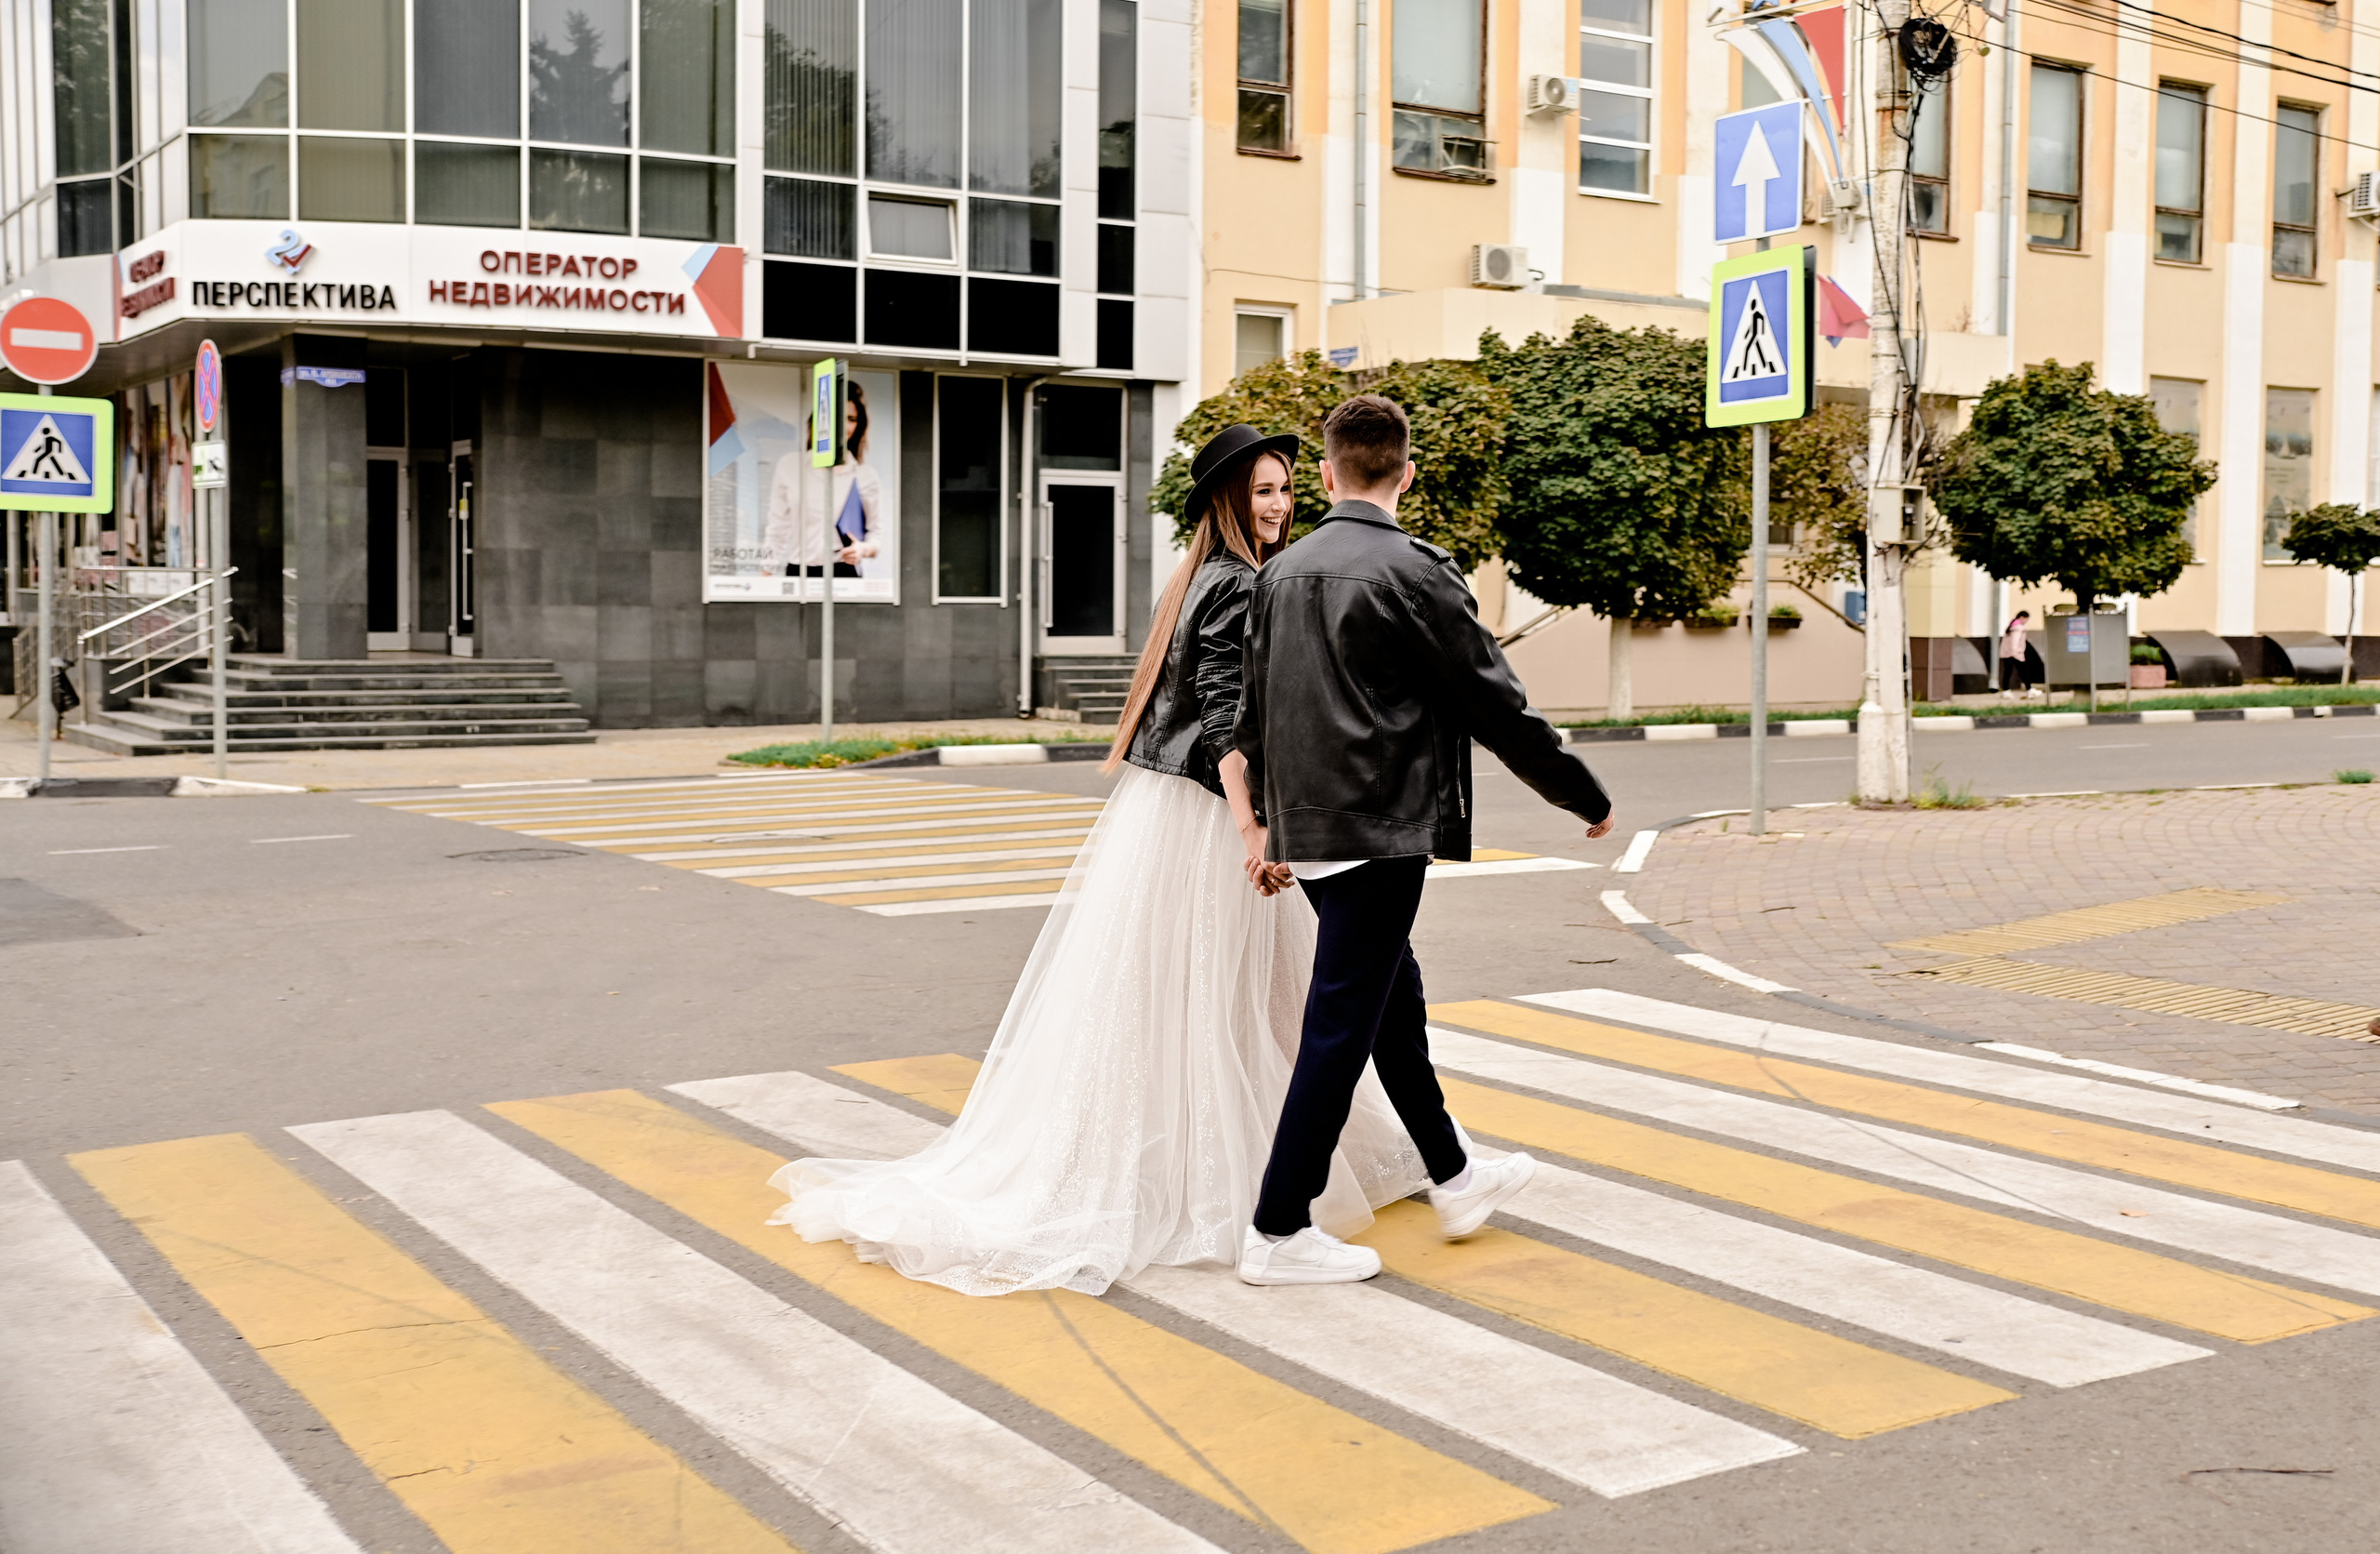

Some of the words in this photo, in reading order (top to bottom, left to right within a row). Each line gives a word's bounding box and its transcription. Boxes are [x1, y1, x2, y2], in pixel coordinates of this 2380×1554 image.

[480, 249, 638, 280] ОПЕРАТОР
[192, 280, 397, 311] ПЕРСПЕКТИВА
[429, 279, 685, 315] НЕДВИЖИМОСТИ
